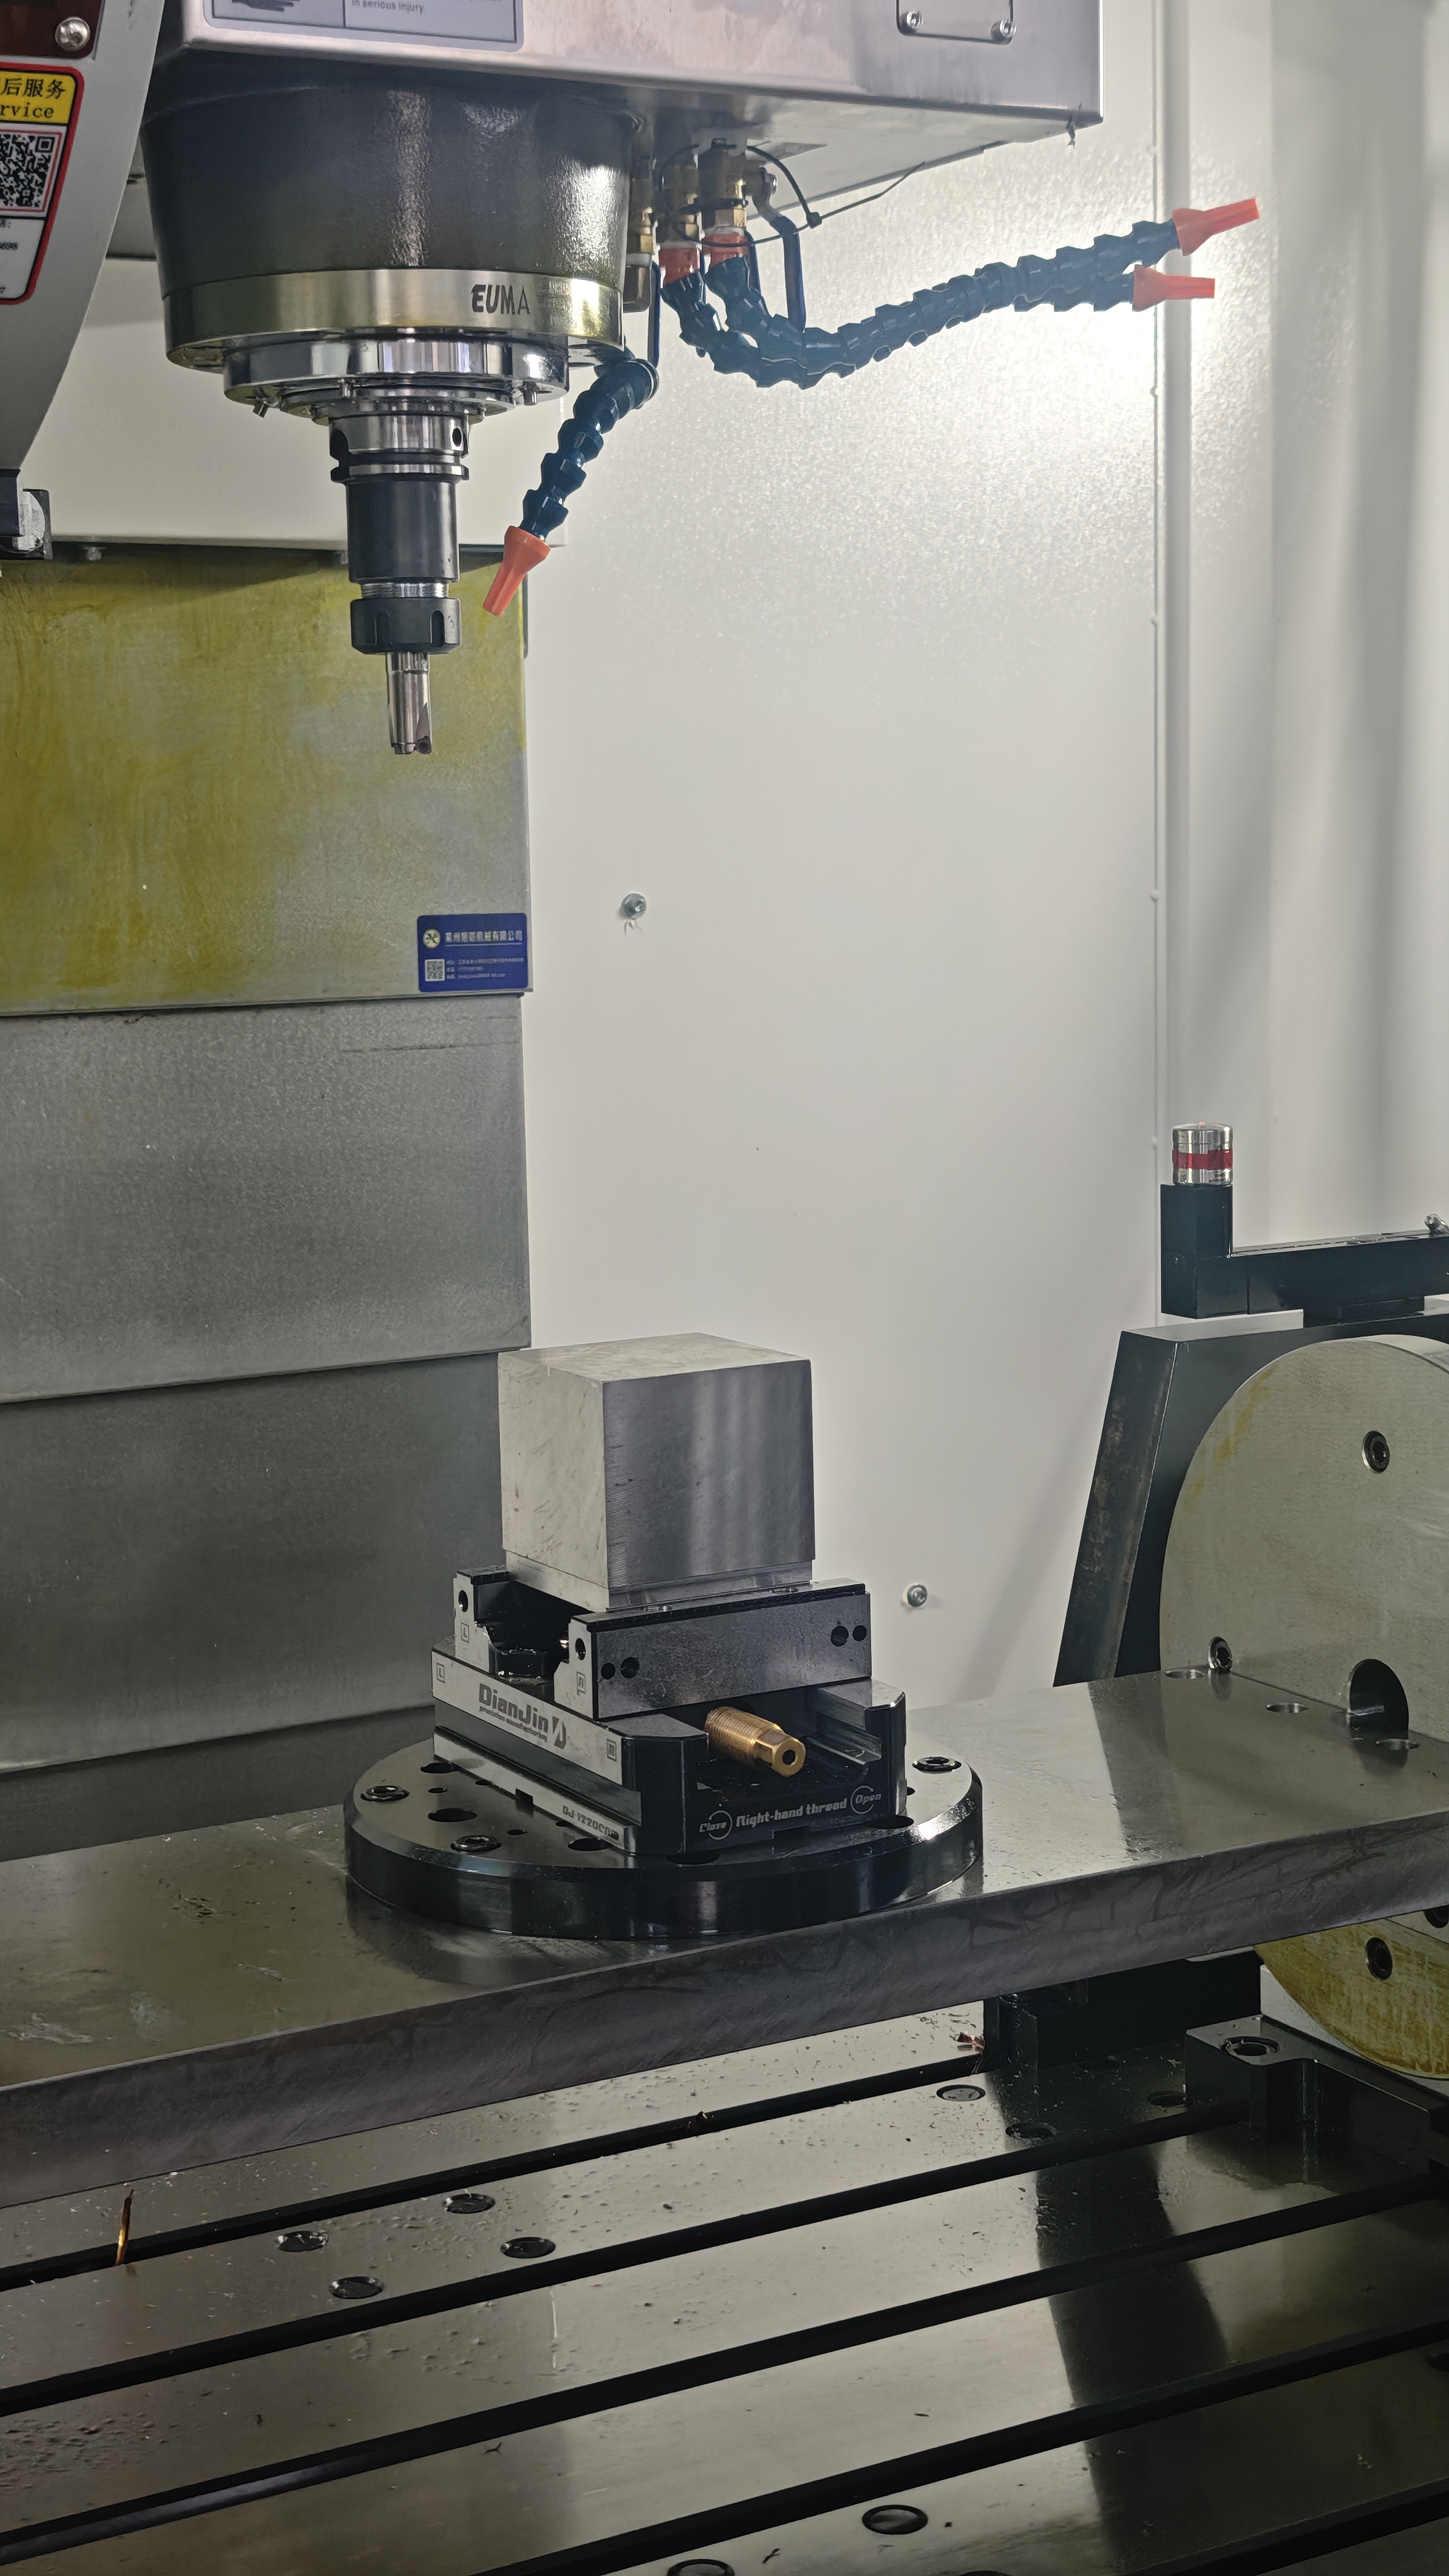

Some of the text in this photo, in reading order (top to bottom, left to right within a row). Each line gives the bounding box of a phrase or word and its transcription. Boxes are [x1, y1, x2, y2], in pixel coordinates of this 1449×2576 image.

[362, 1, 396, 10] serious
[398, 3, 425, 14] injury
[0, 102, 54, 118] rvice
[471, 284, 531, 316] EUMA
[479, 1683, 548, 1733] DianJin
[736, 1804, 804, 1828] Right-hand
[806, 1797, 848, 1815] thread
[855, 1793, 882, 1806] Open
